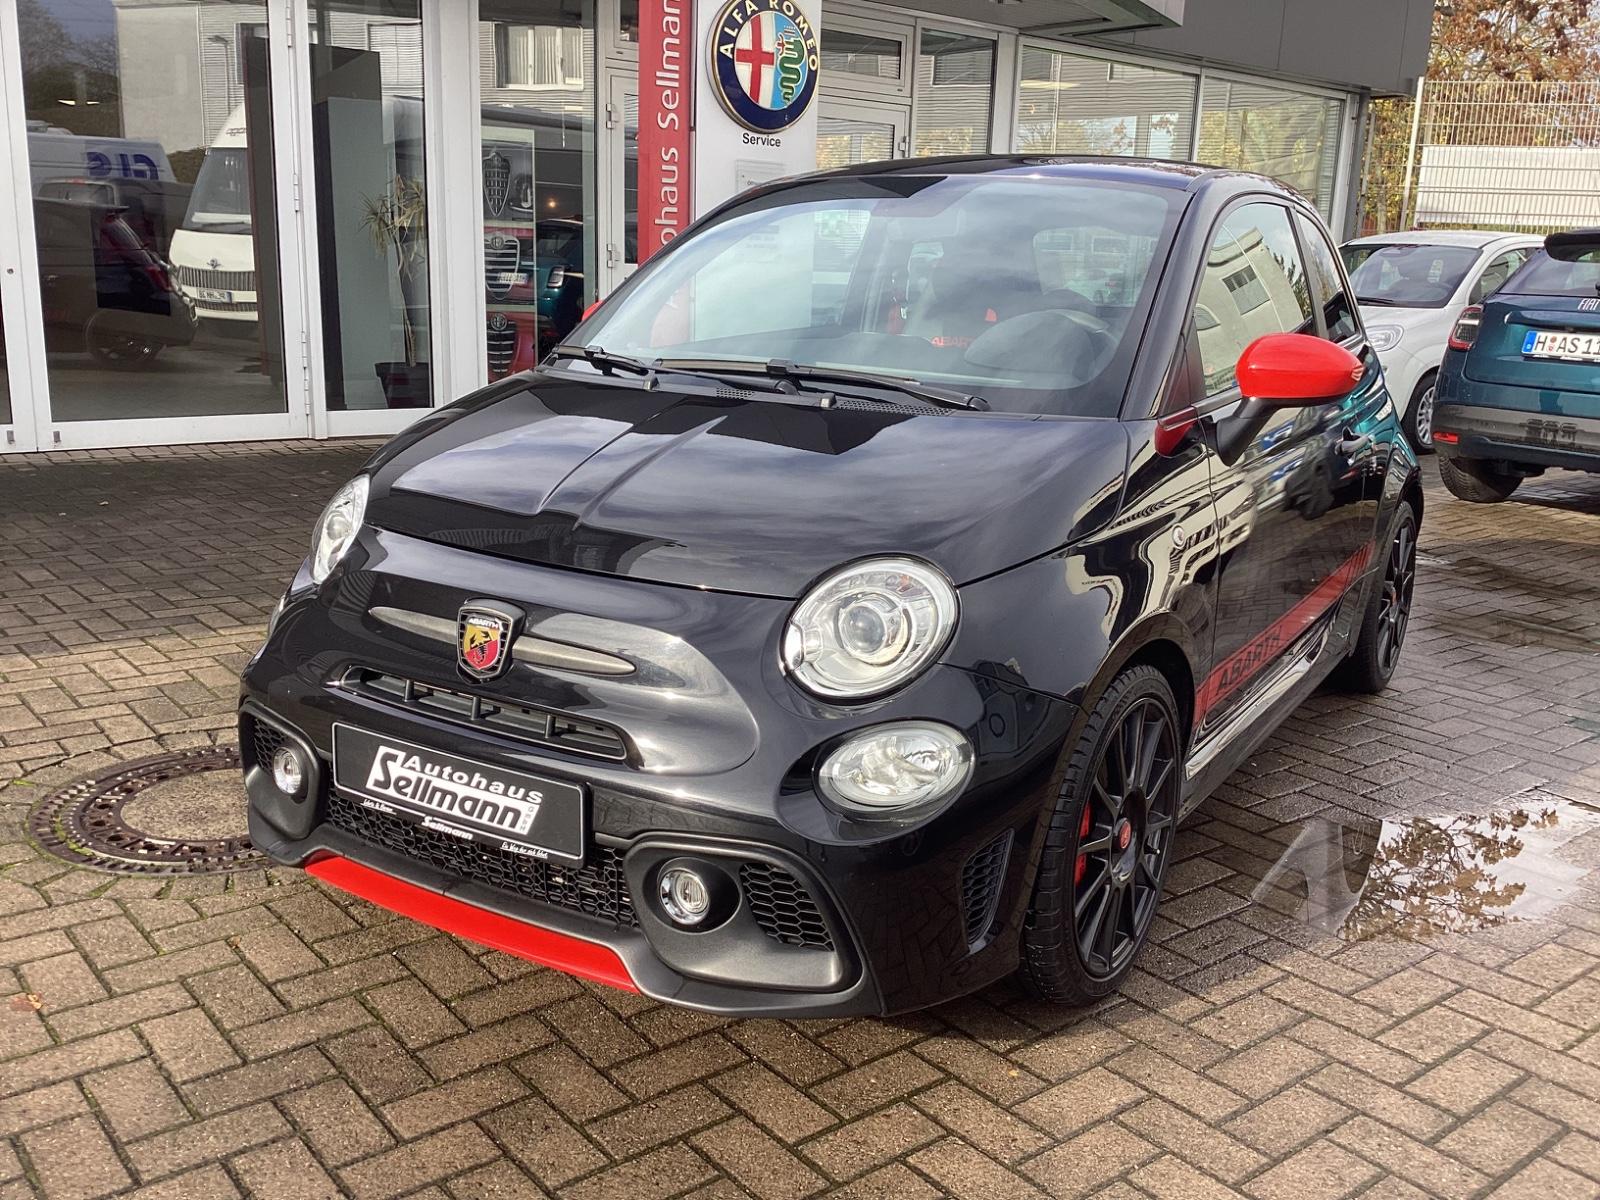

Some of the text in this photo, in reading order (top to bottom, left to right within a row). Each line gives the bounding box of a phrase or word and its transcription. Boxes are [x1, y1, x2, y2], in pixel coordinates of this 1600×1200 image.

[719, 0, 818, 71] ALFA ROMEO
[654, 0, 681, 246] ohaus Sellman
[742, 133, 781, 147] Service
[1577, 298, 1600, 311] FIAT
[1534, 335, 1548, 351] H
[1556, 336, 1581, 354] AS
[468, 617, 499, 629] ABARTH
[1216, 624, 1282, 697] ABARTH
[372, 751, 522, 829] Sellmann
[403, 755, 544, 804] Autohaus
[421, 815, 474, 841] Sellmann
